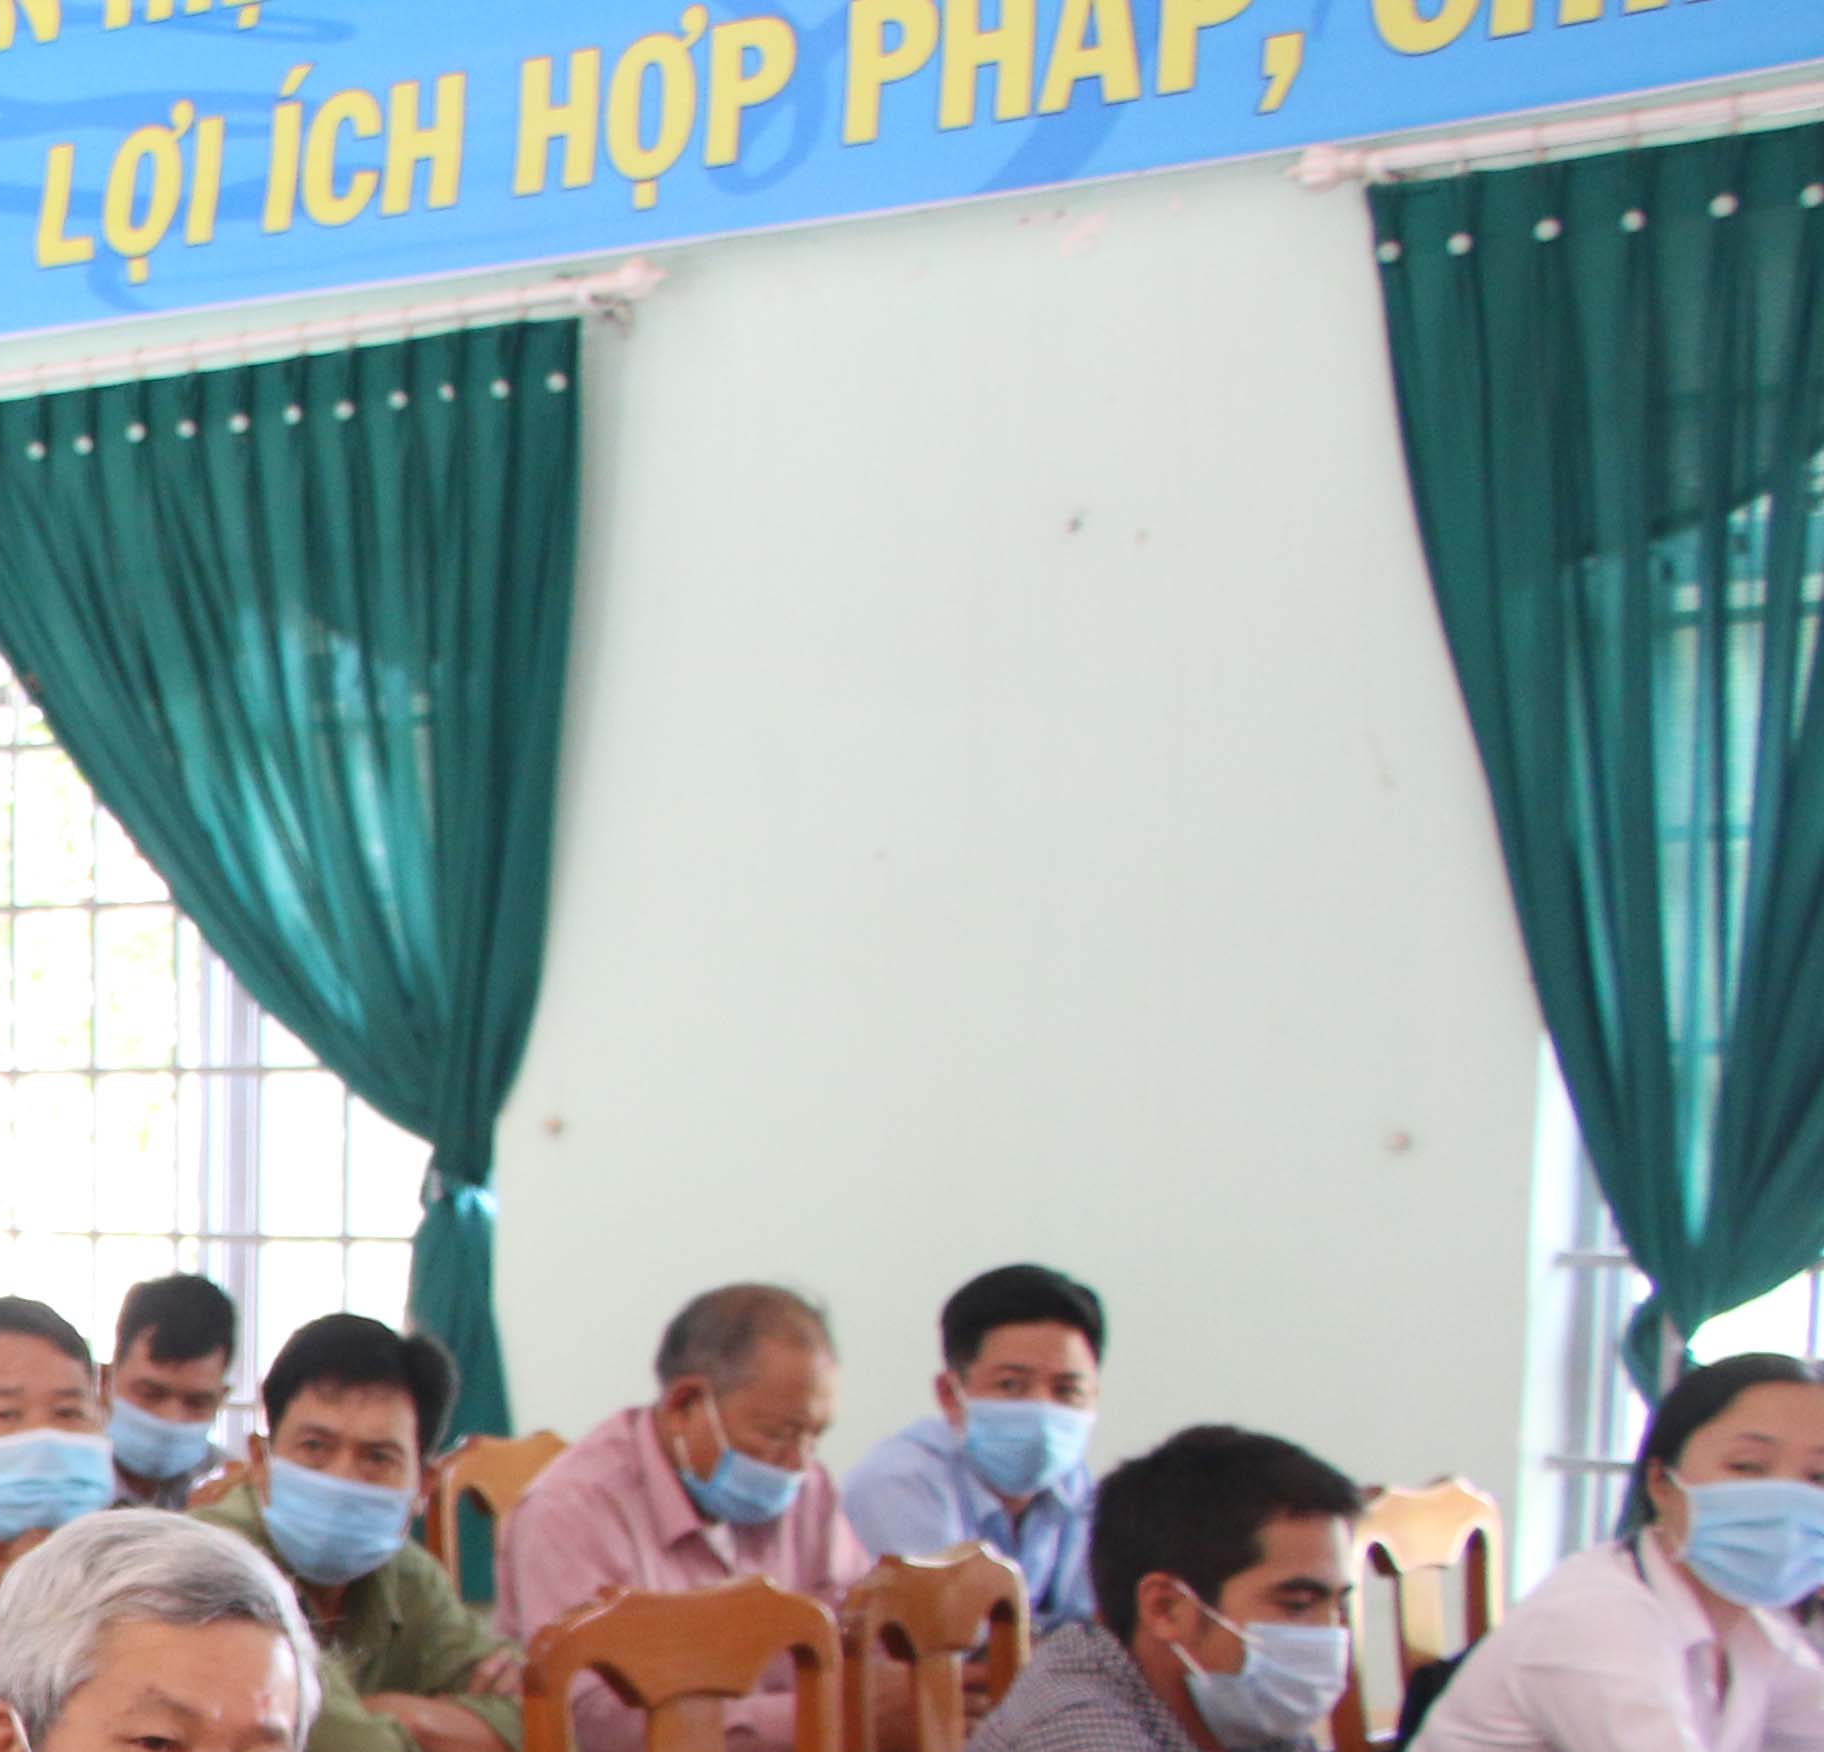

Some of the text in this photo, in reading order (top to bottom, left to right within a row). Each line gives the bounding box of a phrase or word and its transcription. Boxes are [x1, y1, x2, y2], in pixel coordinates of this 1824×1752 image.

[37, 101, 224, 283] LỢI
[264, 62, 468, 234] ÍCH
[515, 5, 796, 208] HỢP
